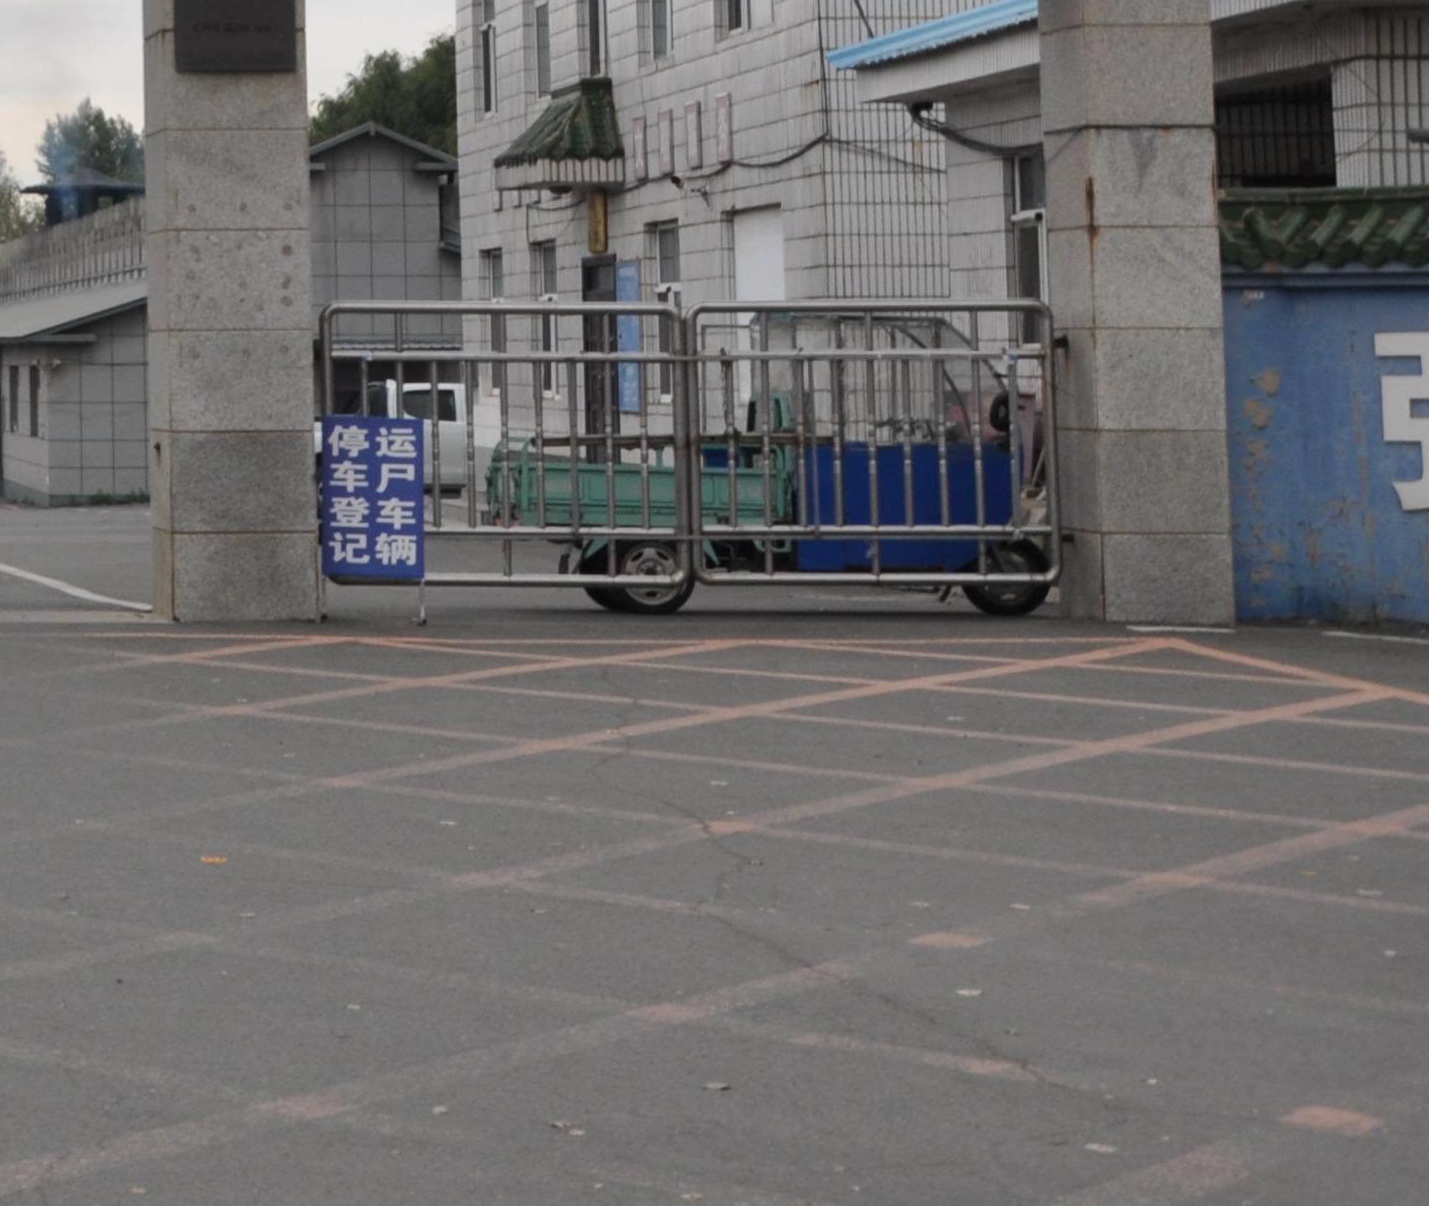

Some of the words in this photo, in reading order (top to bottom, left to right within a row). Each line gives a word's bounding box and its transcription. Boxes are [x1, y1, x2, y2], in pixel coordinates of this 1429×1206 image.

[327, 424, 371, 565] 停车登记
[375, 426, 418, 566] 运尸车辆
